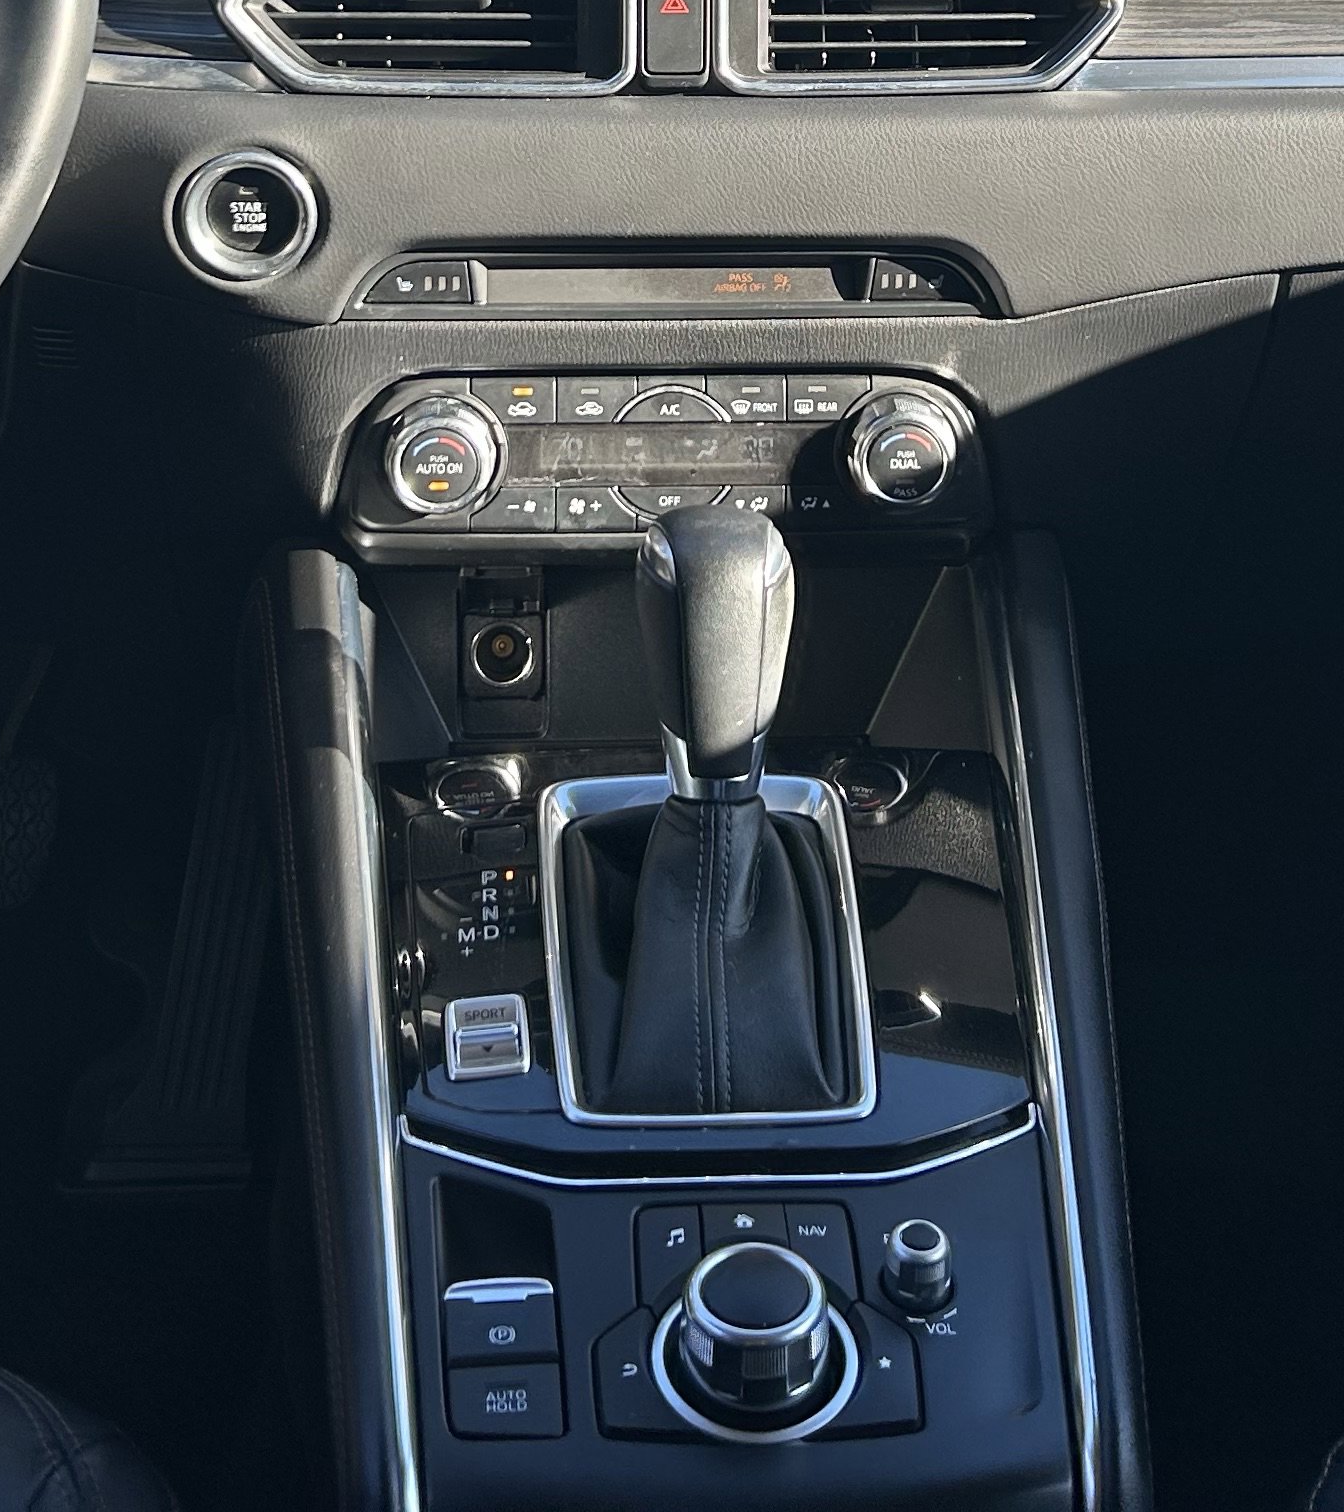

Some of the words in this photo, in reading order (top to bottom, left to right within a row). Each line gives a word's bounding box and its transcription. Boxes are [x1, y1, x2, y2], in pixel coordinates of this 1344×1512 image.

[229, 201, 268, 213] START
[233, 212, 267, 223] STOP
[232, 223, 268, 233] ENGINE
[728, 273, 754, 283] PASS
[713, 283, 747, 293] AIRBAG
[749, 283, 767, 293] OFF
[659, 403, 681, 416] A/C
[752, 402, 778, 413] FRONT
[817, 401, 838, 412] REAR
[429, 454, 449, 463] PUSH
[896, 450, 916, 459] PUSH
[416, 463, 446, 475] AUTO
[446, 462, 464, 474] ON
[889, 458, 922, 470] DUAL
[893, 487, 918, 497] PASS
[658, 495, 681, 507] OFF
[481, 869, 498, 886] P
[481, 888, 498, 903] R
[481, 904, 499, 922] N
[457, 926, 476, 944] M
[483, 924, 500, 941] D
[463, 1007, 507, 1022] SPORT
[797, 1225, 828, 1237] NAV
[924, 1322, 957, 1336] VOL
[486, 1388, 528, 1402] AUTO
[485, 1399, 529, 1413] HOLD
